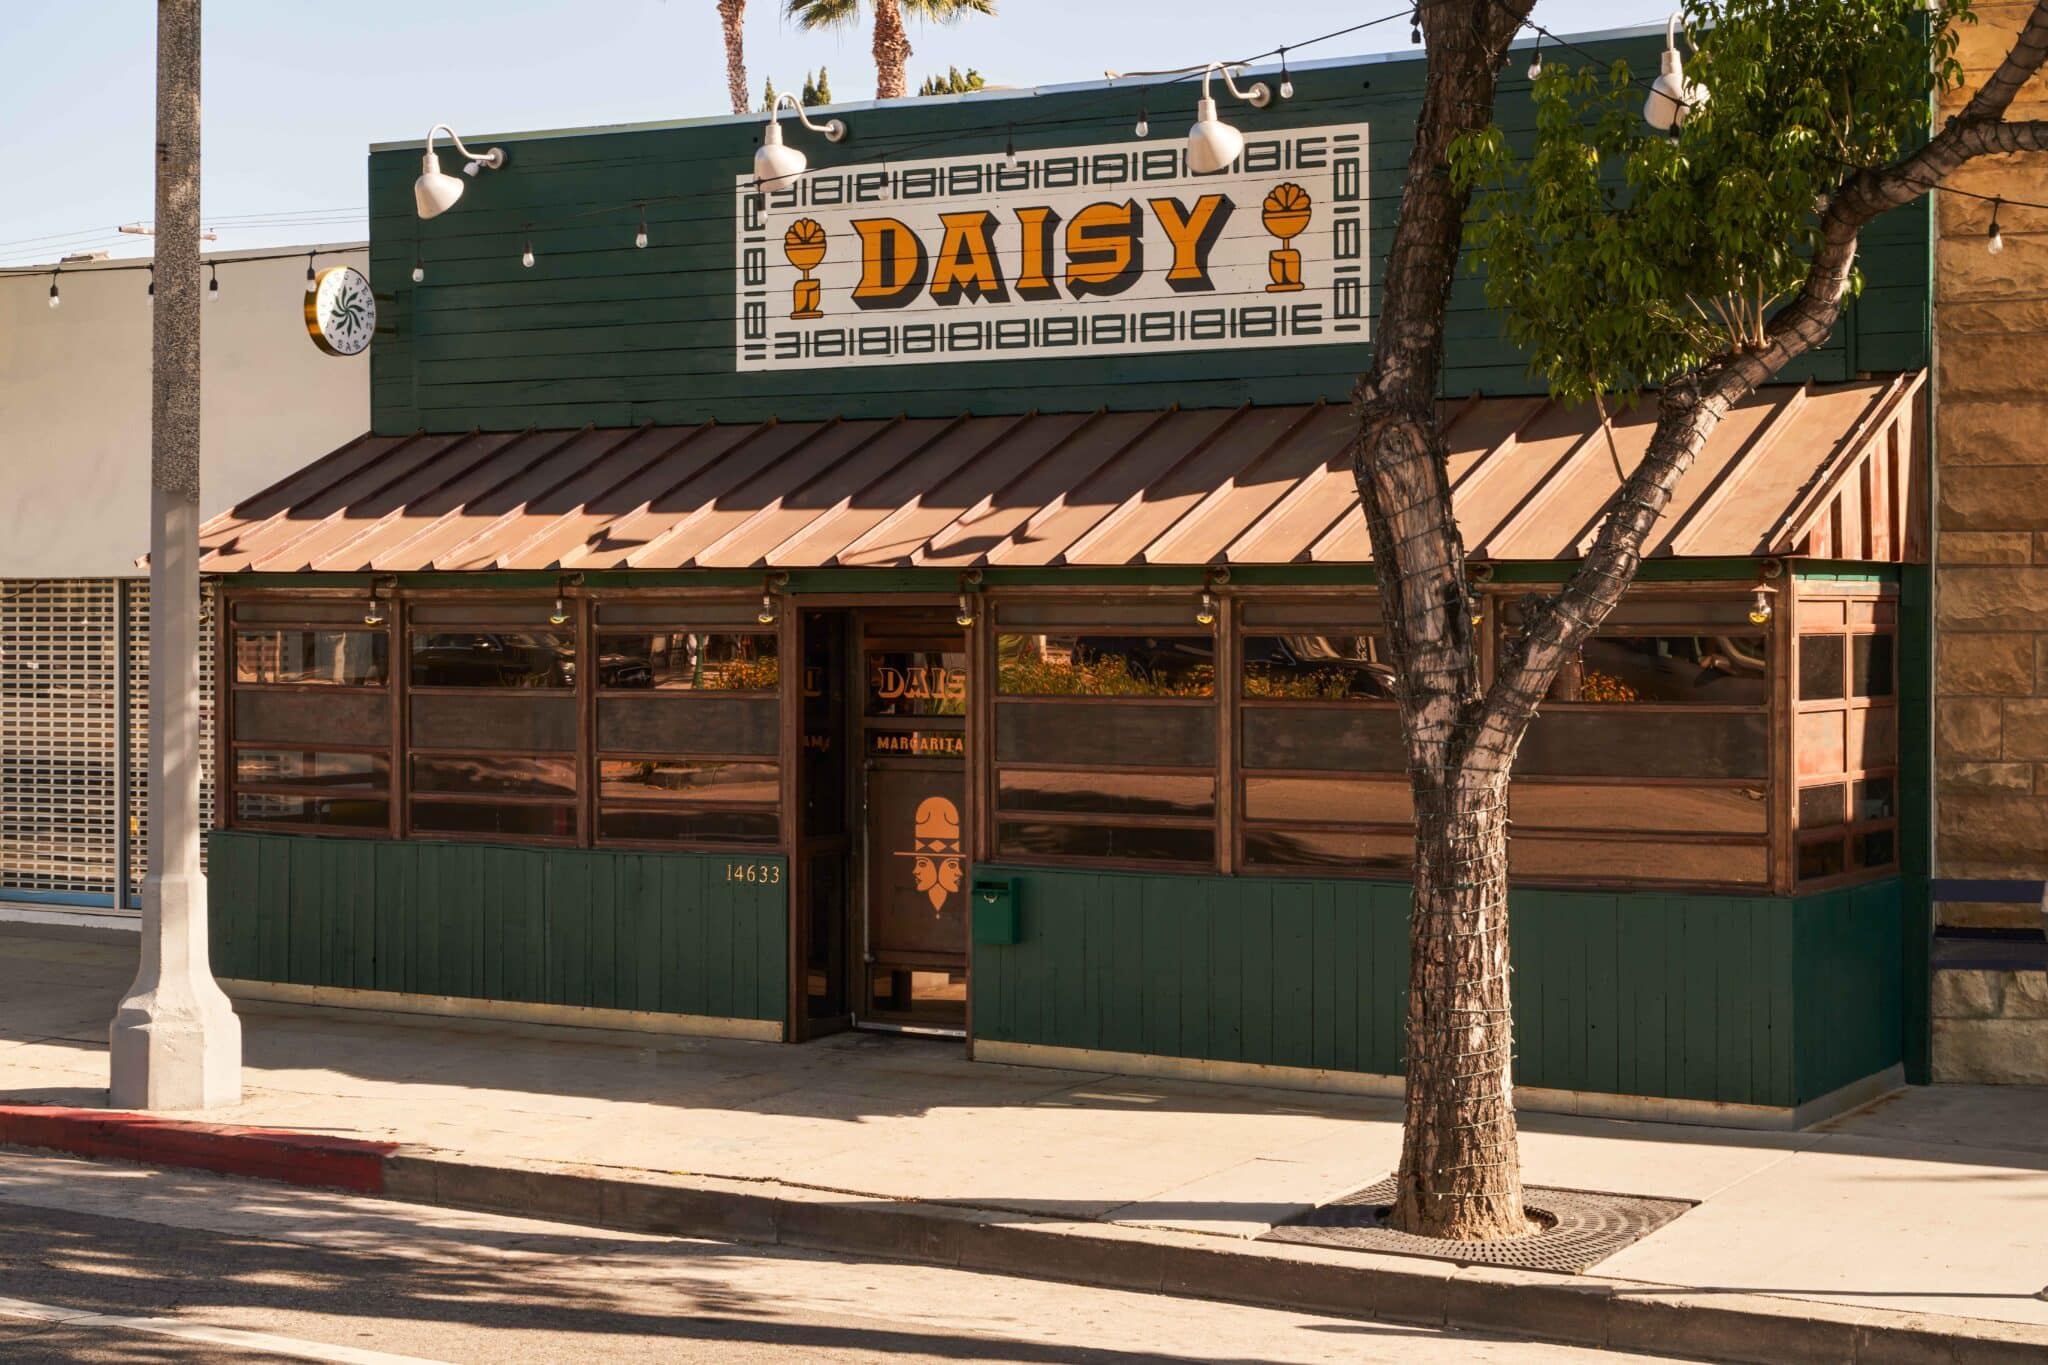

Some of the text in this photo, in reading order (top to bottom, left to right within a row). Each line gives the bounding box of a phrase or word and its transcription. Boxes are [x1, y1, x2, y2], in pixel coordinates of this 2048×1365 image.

[849, 193, 1236, 310] DAISY
[337, 339, 362, 352] BAR
[877, 735, 964, 752] MARGARITA
[726, 864, 780, 884] 14633
